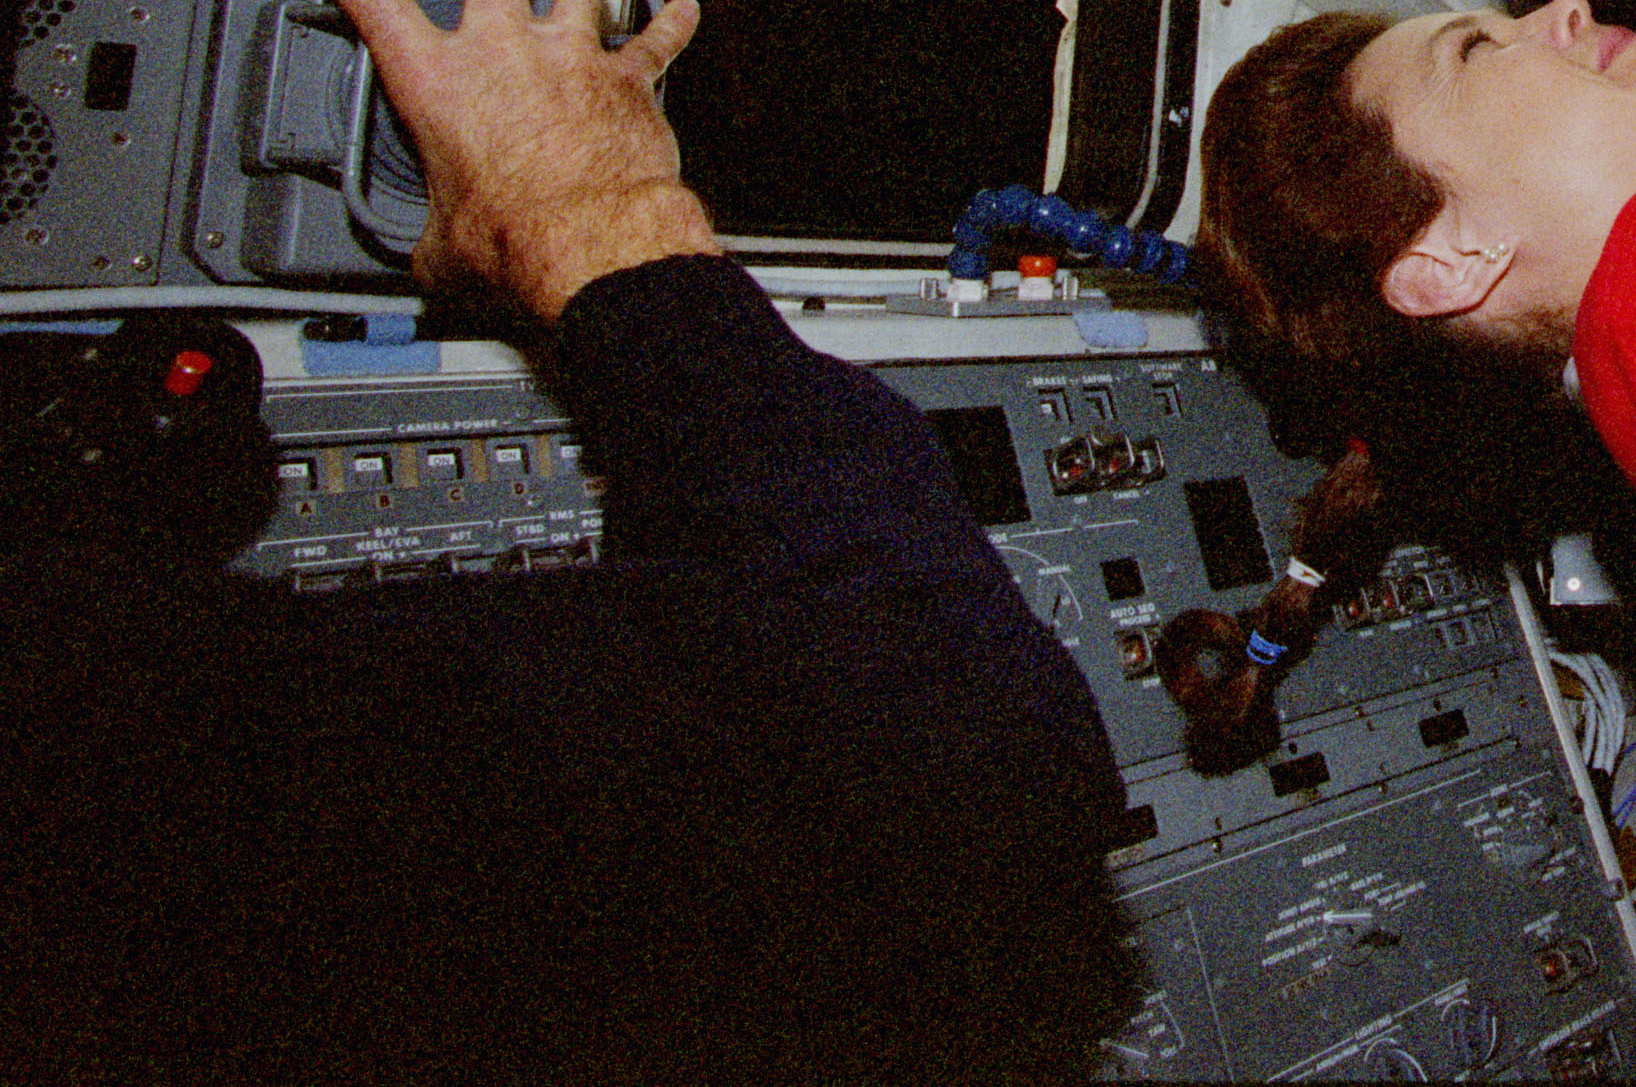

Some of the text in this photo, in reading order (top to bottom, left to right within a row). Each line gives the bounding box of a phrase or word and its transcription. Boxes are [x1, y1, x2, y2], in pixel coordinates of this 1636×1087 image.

[397, 418, 498, 433] CAMERA POWER
[514, 482, 525, 494] D
[379, 494, 391, 507] B
[450, 488, 461, 501] C
[301, 502, 313, 514] A
[549, 509, 575, 521] RMS
[374, 526, 399, 538] BAY
[515, 523, 545, 536] STBD
[293, 530, 471, 557] FWD KEEL/EVA AFT
[551, 532, 569, 543] ON
[371, 552, 394, 562] ON
